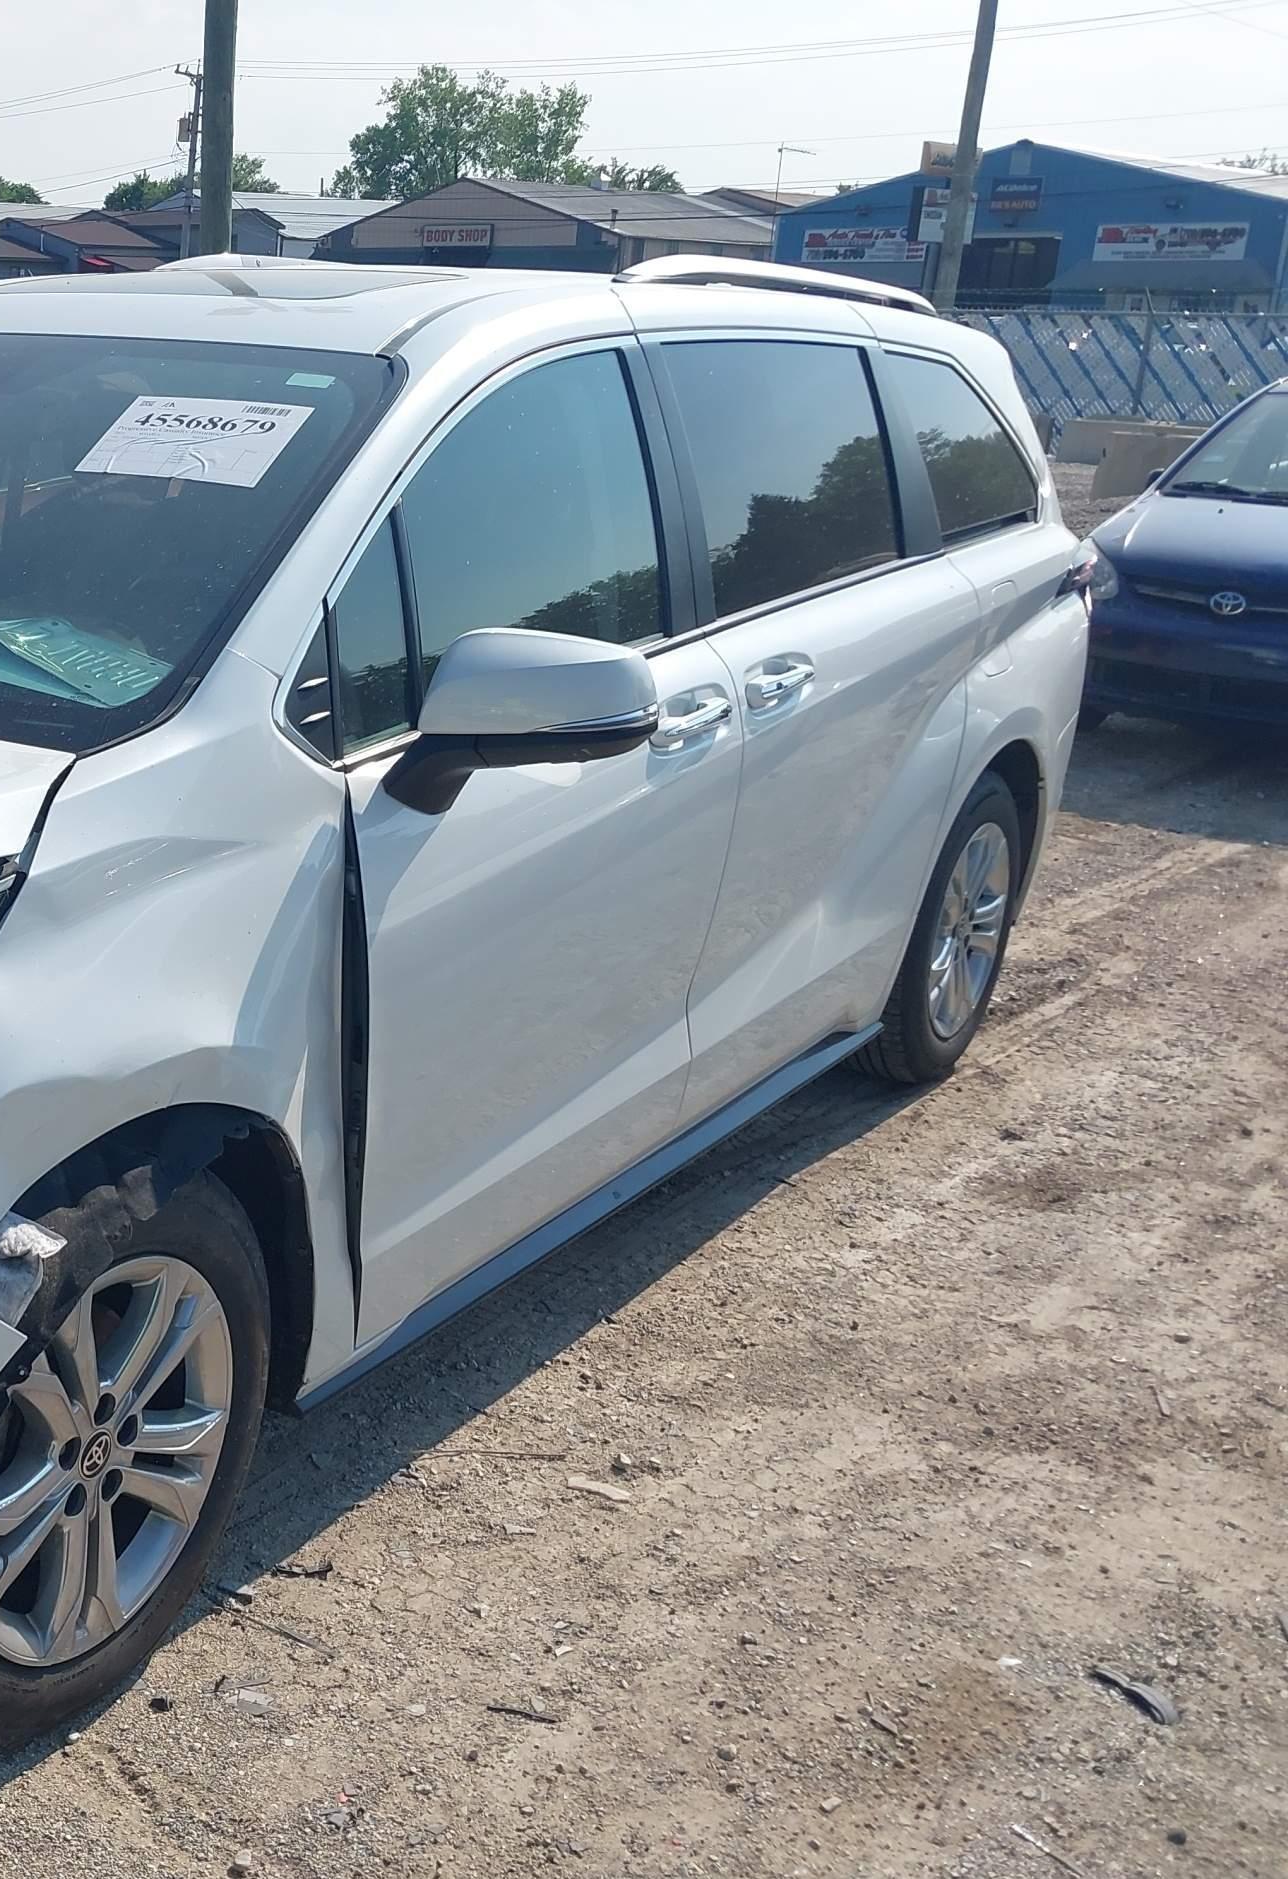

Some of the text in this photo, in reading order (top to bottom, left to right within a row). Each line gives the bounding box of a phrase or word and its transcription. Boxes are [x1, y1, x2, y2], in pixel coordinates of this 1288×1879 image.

[1010, 200, 1037, 209] AUTO
[426, 229, 489, 242] BODY SHOP
[134, 412, 276, 435] 45568679
